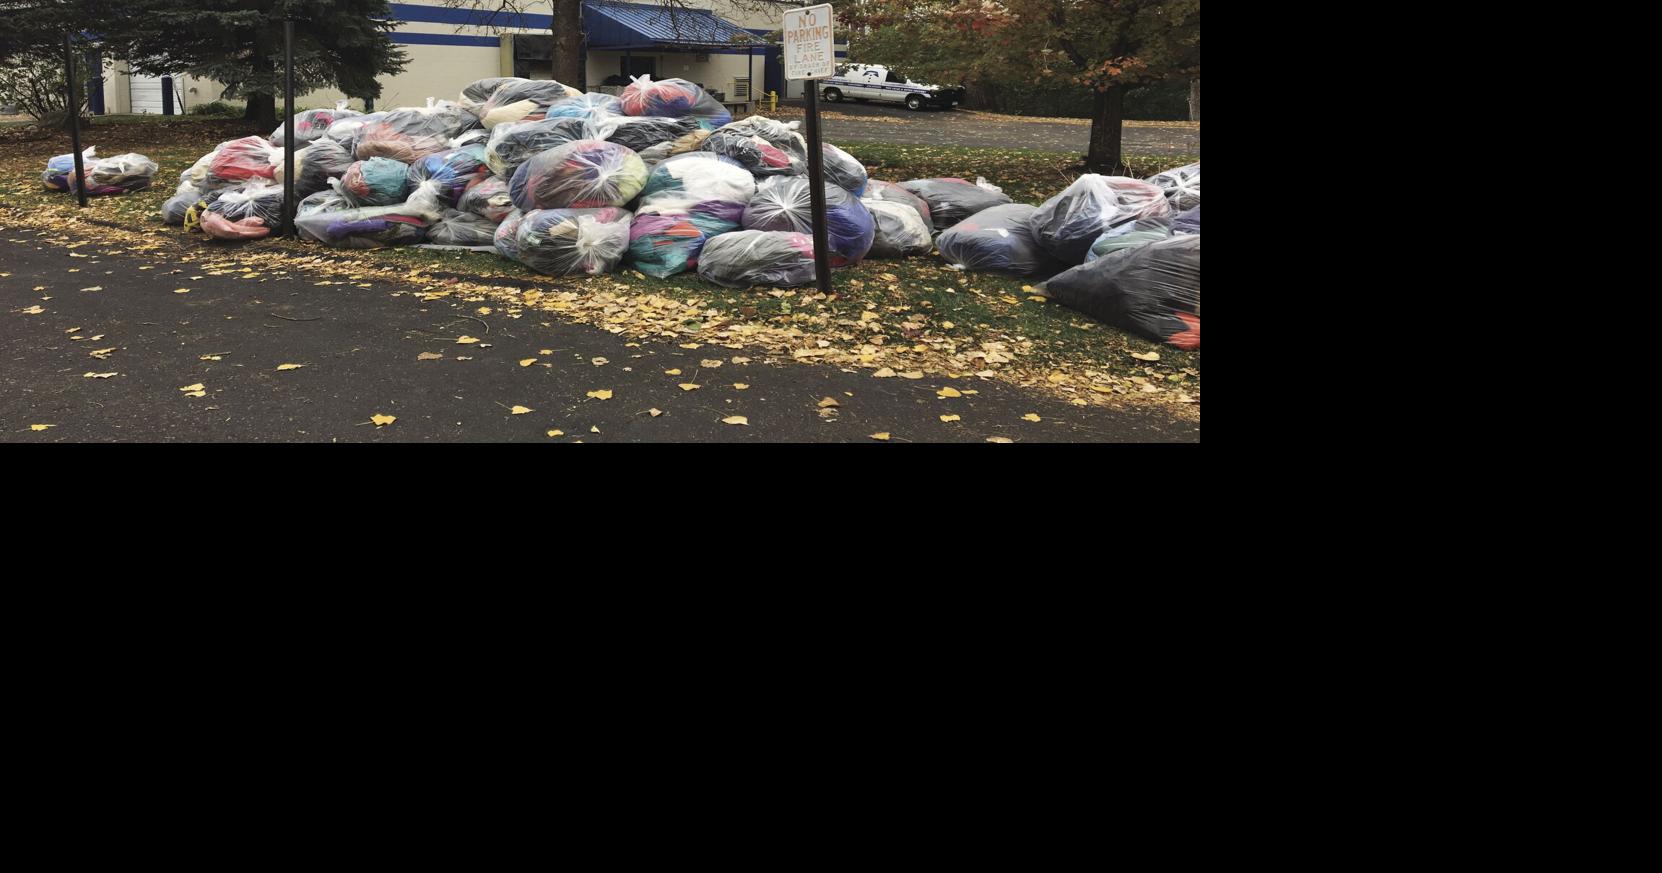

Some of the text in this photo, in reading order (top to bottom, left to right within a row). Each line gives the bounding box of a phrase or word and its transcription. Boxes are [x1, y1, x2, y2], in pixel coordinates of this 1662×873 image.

[799, 14, 816, 28] NO
[788, 26, 828, 43] PARKING
[797, 42, 820, 53] FIRE
[794, 51, 824, 63] LANE
